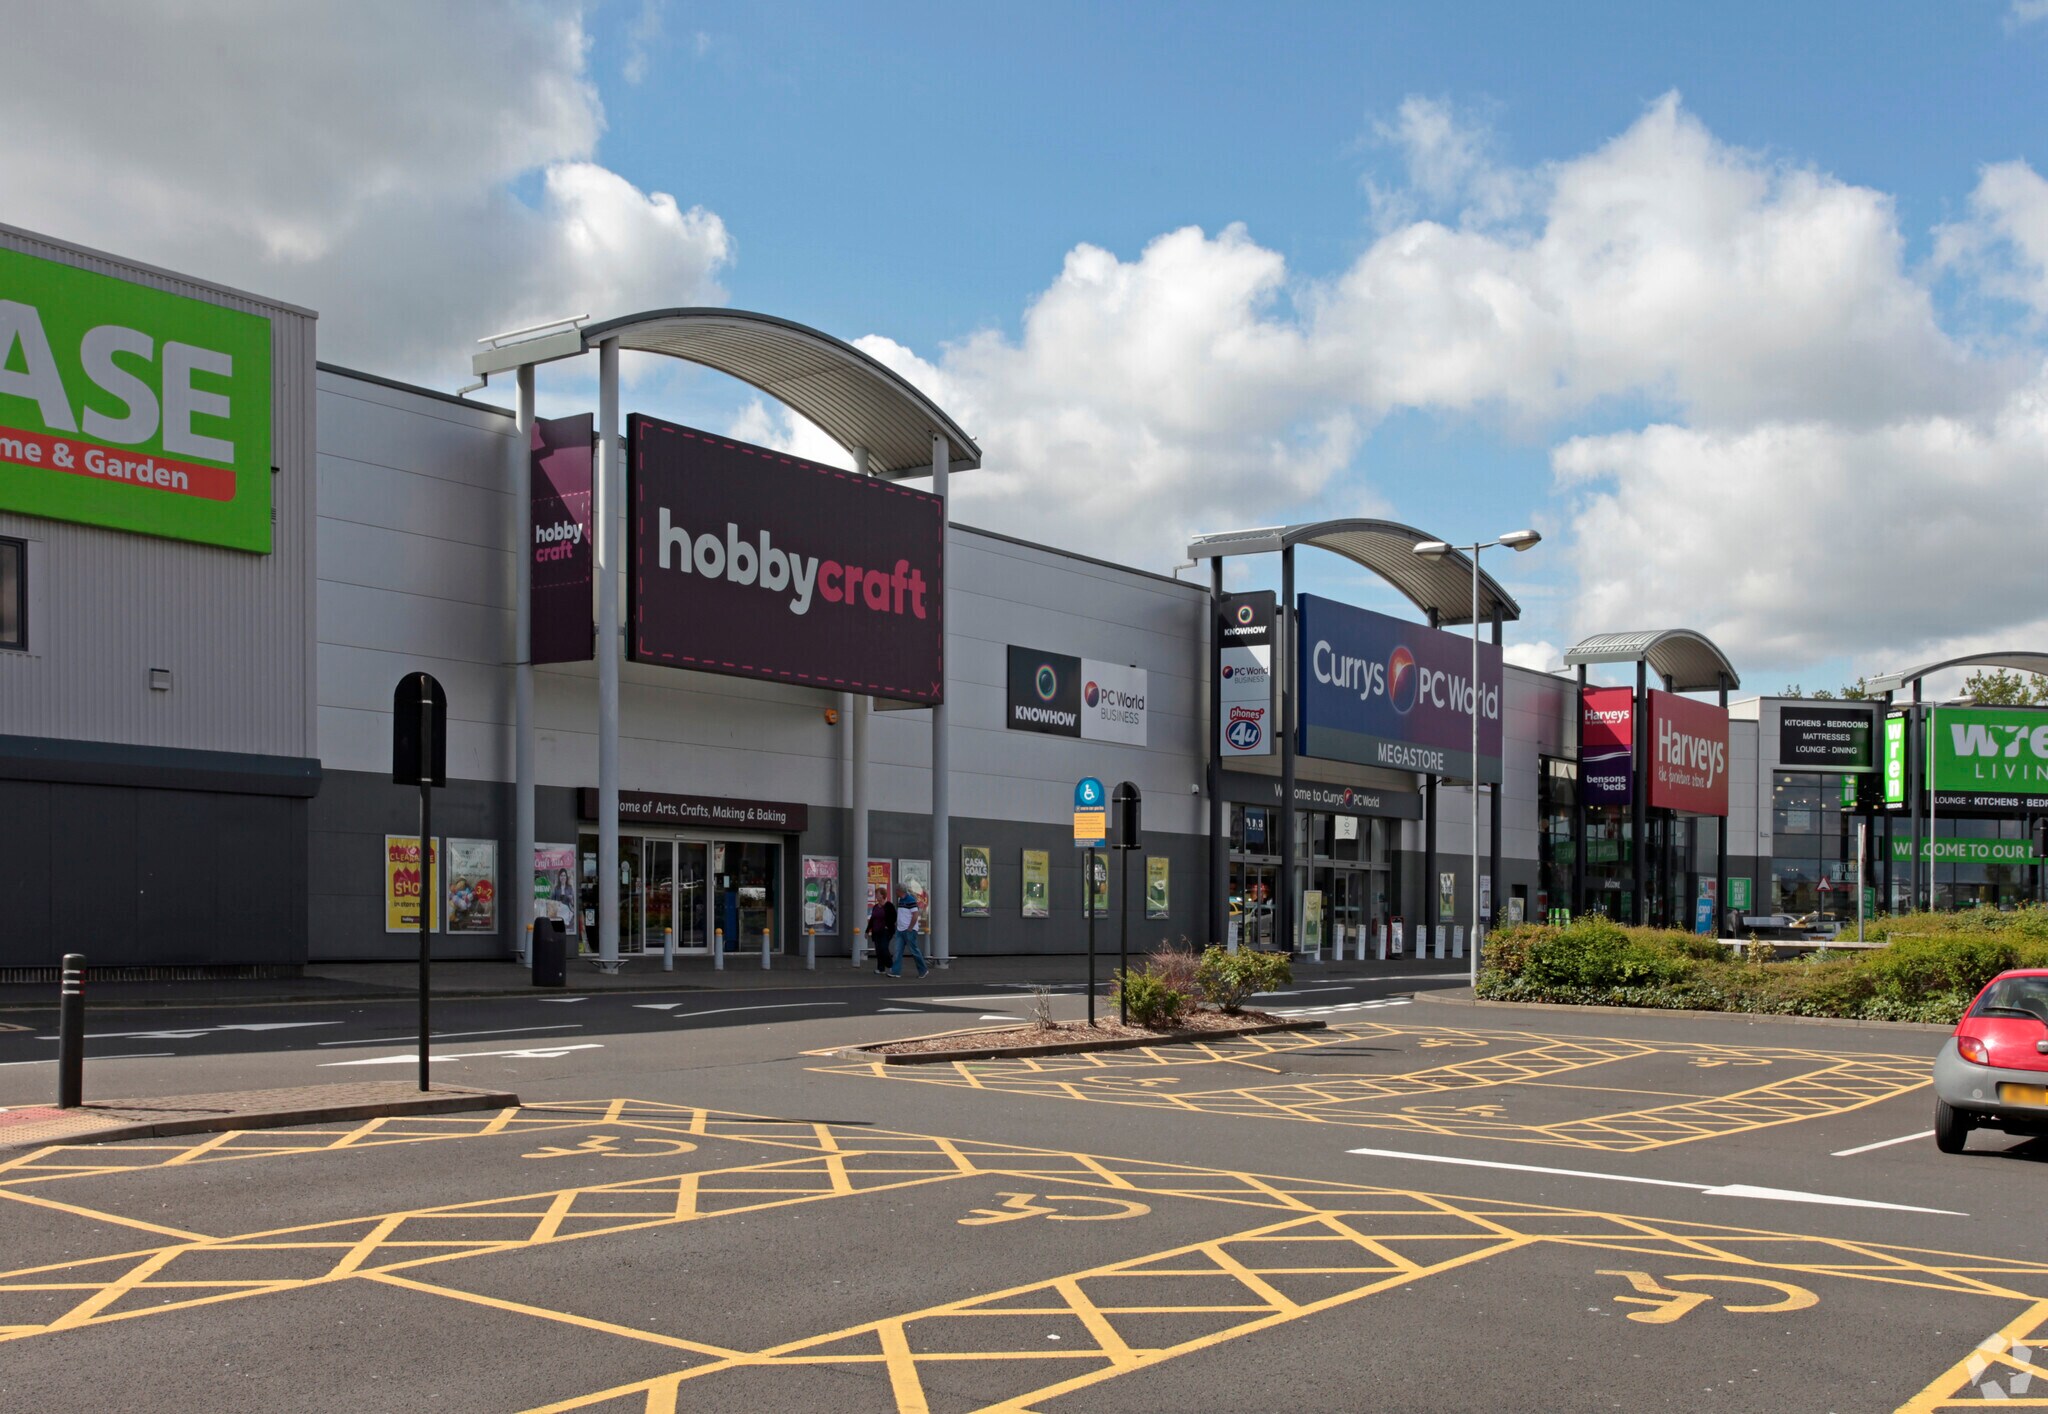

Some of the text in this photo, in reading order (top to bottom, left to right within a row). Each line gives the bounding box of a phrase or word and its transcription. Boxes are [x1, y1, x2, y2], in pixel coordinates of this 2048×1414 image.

[52, 443, 75, 469] &
[84, 450, 188, 490] Garden
[535, 521, 583, 544] hobby
[536, 541, 573, 563] craft
[659, 507, 926, 619] hobbycraft
[1224, 626, 1266, 636] KNOWHOW
[1234, 666, 1268, 675] PC World
[1313, 640, 1385, 701] Currys
[1419, 667, 1446, 709] PC
[1234, 676, 1264, 684] BUSINESS
[1101, 689, 1145, 711] PC World
[1016, 705, 1076, 727] KNOWHOW
[1101, 708, 1139, 725] BUSINESS
[1231, 709, 1260, 720] phones
[1584, 710, 1630, 723] Harveys
[1784, 719, 1869, 729] KITCHENS BEDROOMS
[1231, 722, 1257, 745] 4u
[1803, 733, 1850, 741] MATTRESSES
[1378, 742, 1444, 770] MEGASTORE
[1658, 718, 1724, 788] Harveys
[1796, 745, 1857, 754] LOUNGE DINING
[1888, 723, 1902, 797] wren
[1586, 775, 1626, 783] bensons
[1603, 783, 1626, 791] beds
[1274, 783, 1379, 808] Wome to Currys PC World
[1935, 796, 1966, 805] LOUNGE
[1974, 797, 2019, 807] KITCHENS
[620, 801, 786, 825] ome of Arts, Crafts, Making & Baking
[389, 853, 434, 863] CLEARAE
[1969, 844, 1989, 858] TO
[1993, 845, 2024, 859] OUR
[395, 880, 421, 895] SHO
